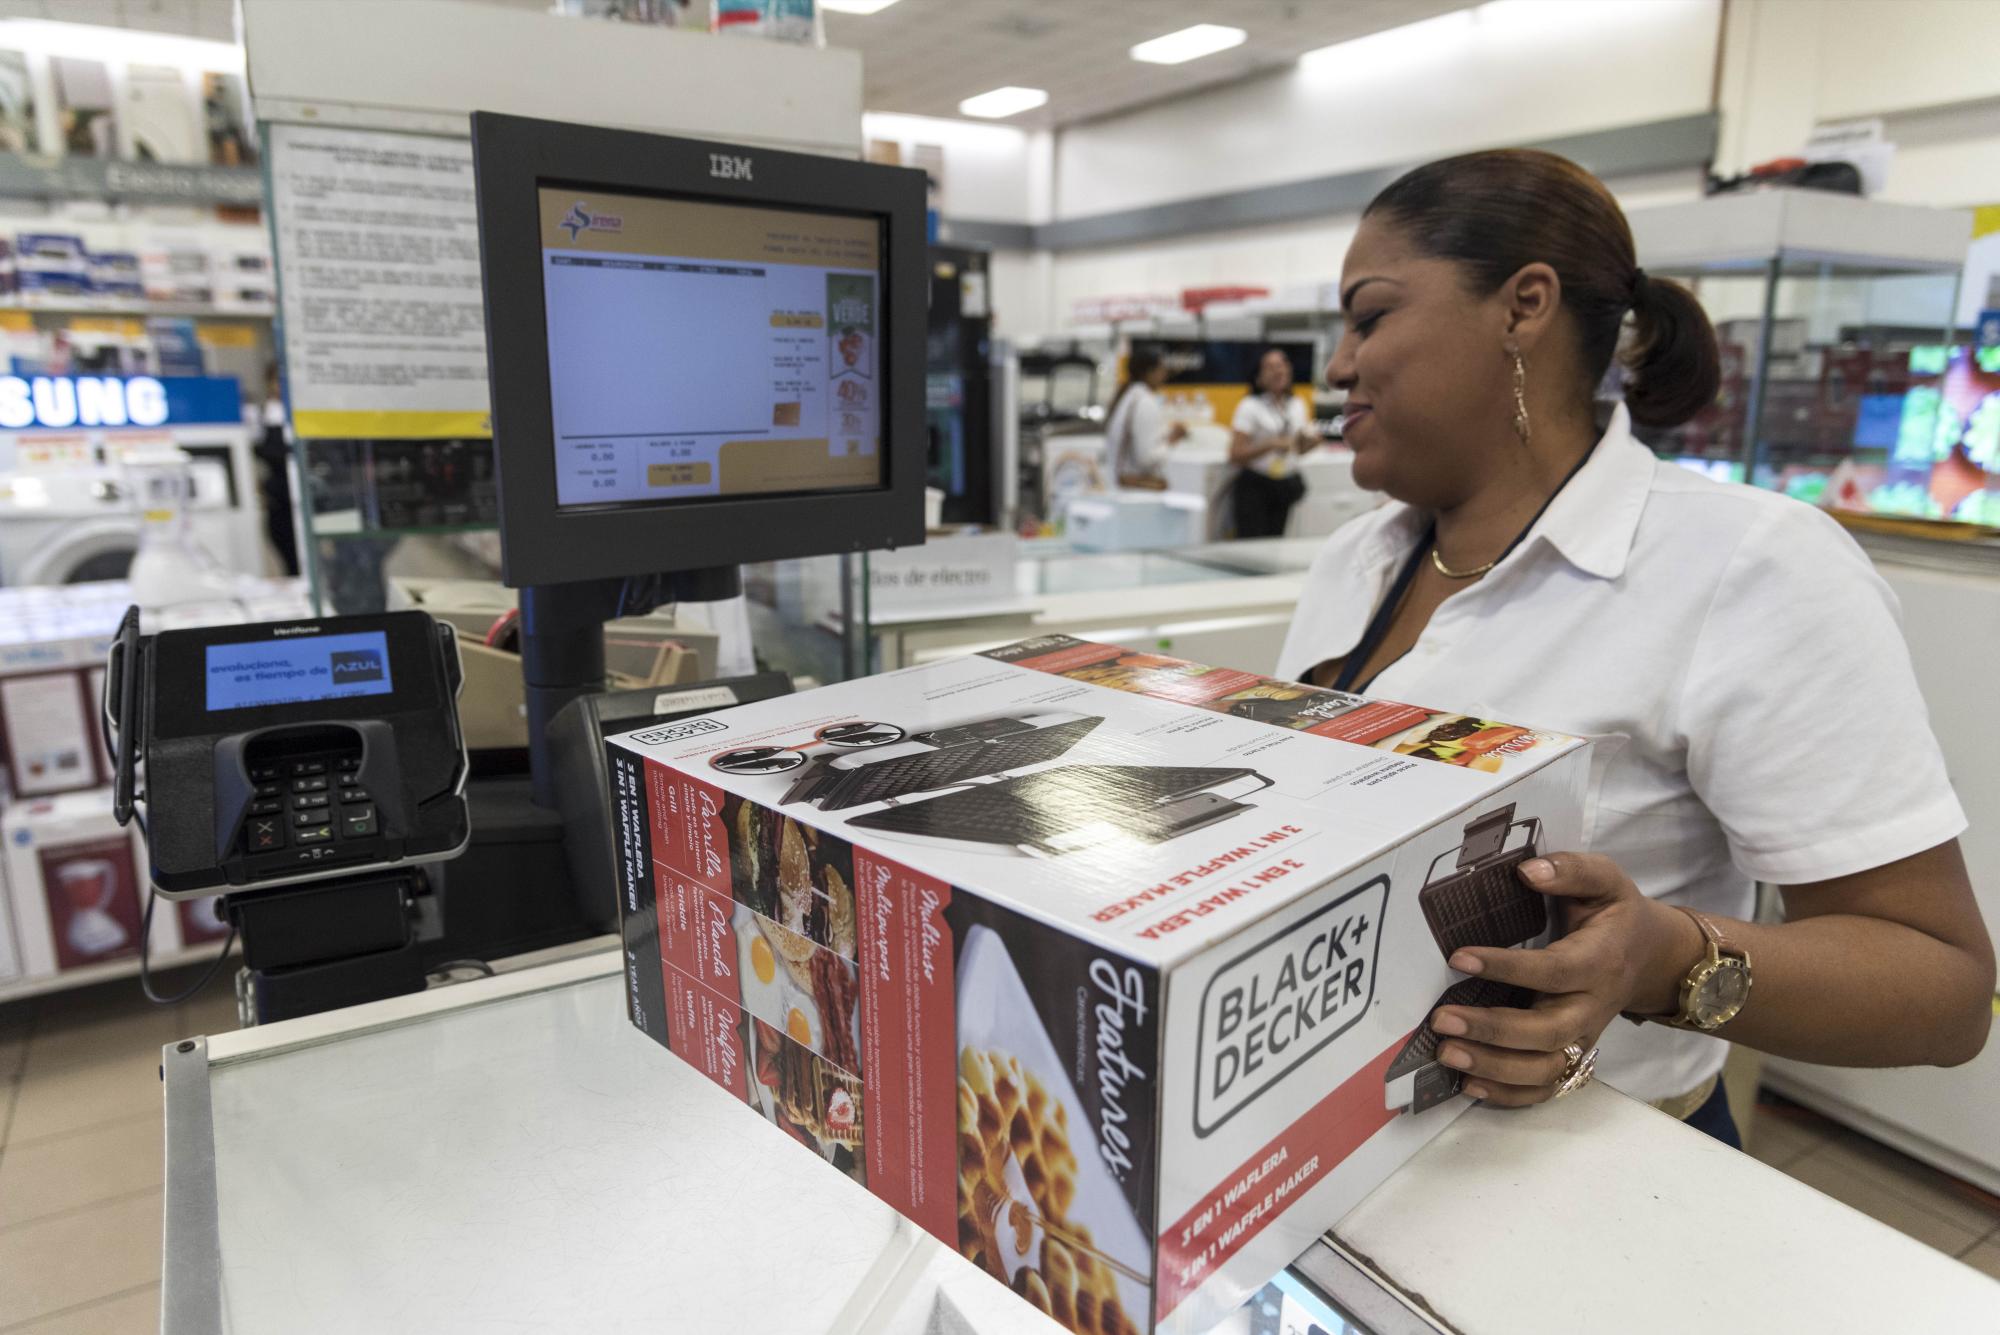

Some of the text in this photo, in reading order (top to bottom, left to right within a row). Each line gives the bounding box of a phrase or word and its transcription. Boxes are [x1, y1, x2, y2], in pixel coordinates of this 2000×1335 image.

[709, 153, 753, 181] IBM
[590, 452, 615, 462] 0.00
[254, 667, 307, 683] tiempo
[309, 665, 329, 676] de
[334, 660, 381, 673] AZUL
[641, 721, 709, 739] DECKER
[616, 758, 623, 768] 3
[617, 770, 625, 787] IN
[627, 763, 634, 773] 3
[628, 775, 637, 796] EN
[668, 785, 677, 813] Grill
[620, 799, 632, 858] WAFFLE
[692, 816, 697, 828] en
[693, 829, 700, 839] el
[699, 790, 721, 878] Parrilla
[1260, 831, 1289, 843] IN
[632, 809, 644, 878] WAFLERA
[626, 860, 636, 911] MAKER
[1169, 847, 1256, 886] WAFFLE
[1253, 866, 1290, 882] EN
[677, 884, 687, 931] Griddle
[692, 886, 700, 924] favoritos
[696, 926, 701, 937] de
[1092, 884, 1175, 922] MAKER
[1138, 888, 1248, 939] WAFLERA
[709, 900, 730, 977] Plancha
[875, 865, 892, 981] Multipurpose
[920, 889, 940, 984] Multiuso
[1217, 915, 1369, 1040] BLACK+
[686, 990, 695, 1029] Waffle
[1213, 958, 1364, 1098] DECKER
[716, 1008, 736, 1085] Waflera
[1182, 1147, 1288, 1247] 3 EN 1 WAFLERA
[1181, 1155, 1319, 1286] 3 IN 1 WAFFLE MAKER
